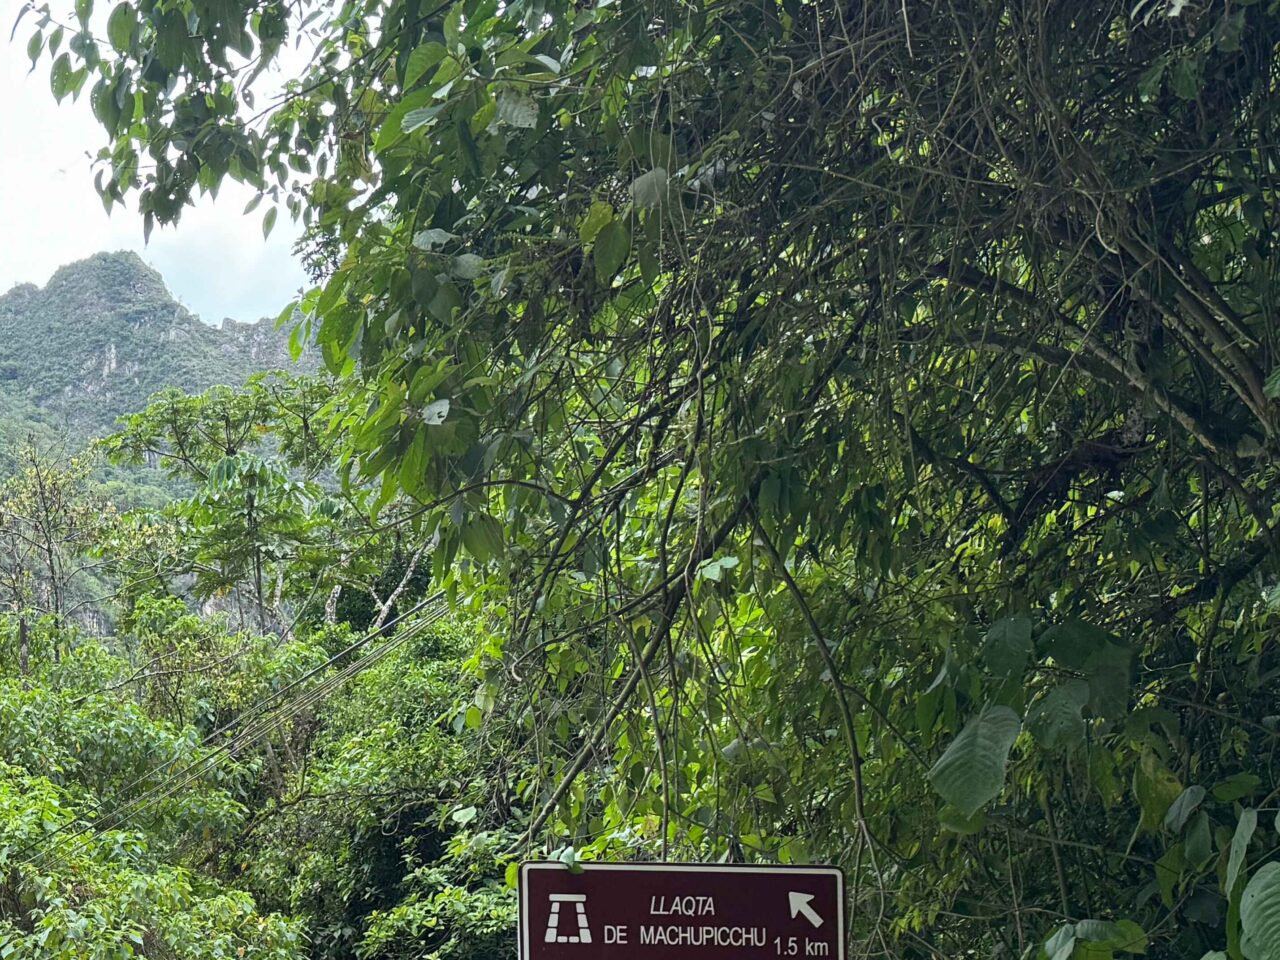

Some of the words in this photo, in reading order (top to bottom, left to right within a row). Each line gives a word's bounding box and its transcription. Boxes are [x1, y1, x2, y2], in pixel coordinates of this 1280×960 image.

[650, 896, 715, 917] LLAQTA
[604, 925, 628, 944] DE
[639, 925, 767, 947] MACHUPICCHU
[773, 936, 798, 956] 1.5
[805, 937, 829, 956] km
